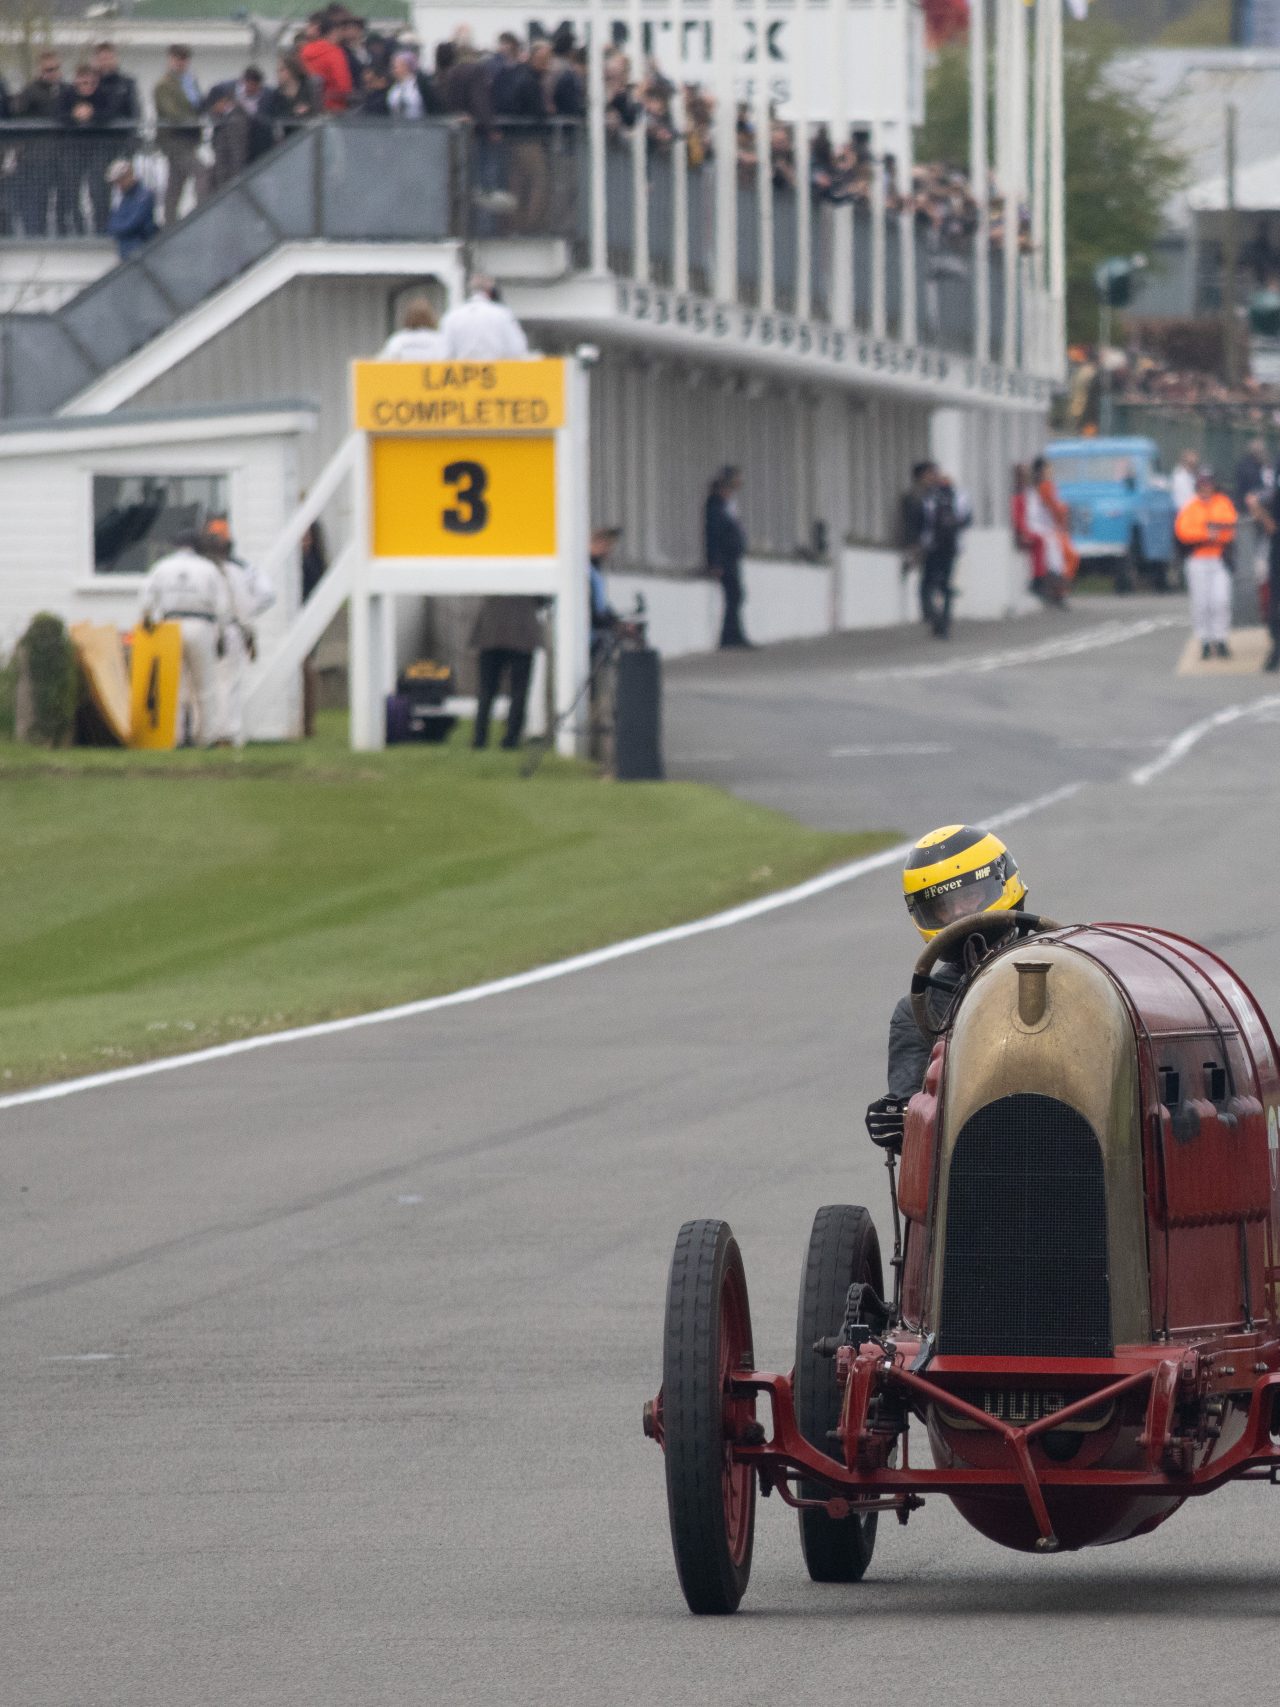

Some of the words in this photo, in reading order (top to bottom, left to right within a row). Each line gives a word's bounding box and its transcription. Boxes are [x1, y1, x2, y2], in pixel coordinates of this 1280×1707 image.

[422, 364, 497, 390] LAPS
[373, 398, 549, 425] COMPLETED
[442, 460, 490, 535] 3
[924, 879, 963, 900] #Fever
